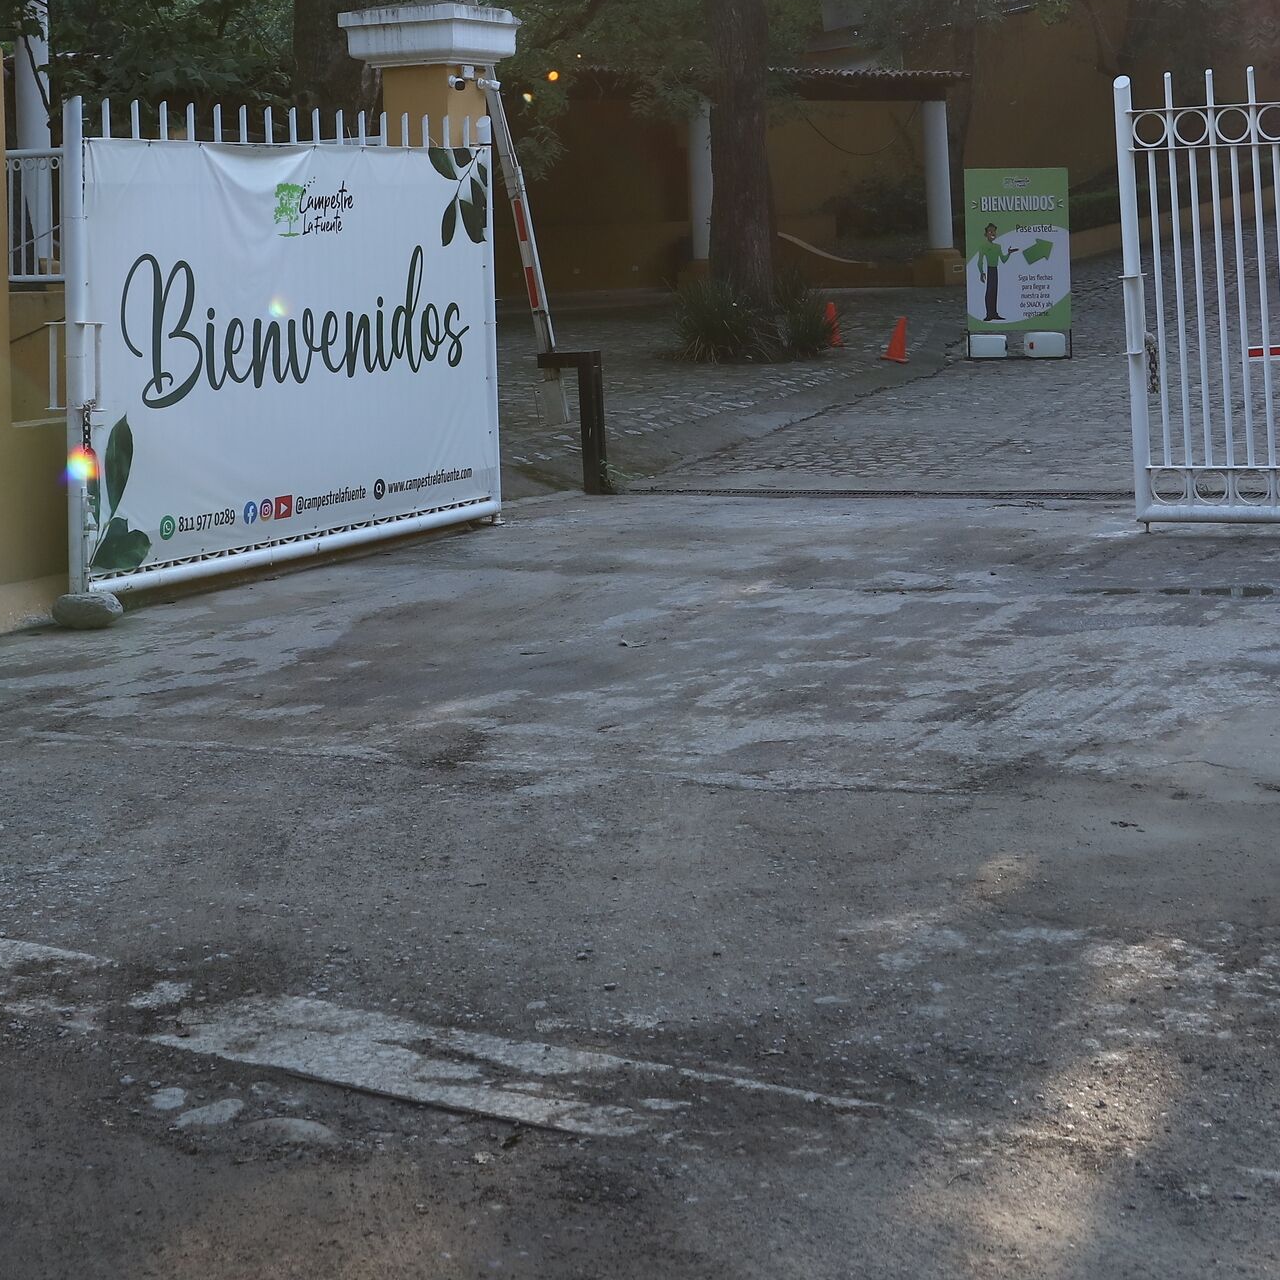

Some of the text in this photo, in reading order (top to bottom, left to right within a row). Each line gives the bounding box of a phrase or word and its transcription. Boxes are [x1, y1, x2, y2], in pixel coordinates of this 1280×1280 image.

[299, 180, 353, 217] Campestre
[981, 195, 1055, 212] BIENVENIDOS
[302, 209, 343, 235] La Fuente
[1015, 223, 1032, 233] Pase
[120, 244, 470, 409] Bienvenidos
[387, 466, 473, 495] www.campestrelafuente.com
[295, 485, 367, 515] @campestrelafuente
[178, 508, 236, 533] 811 977 0289
